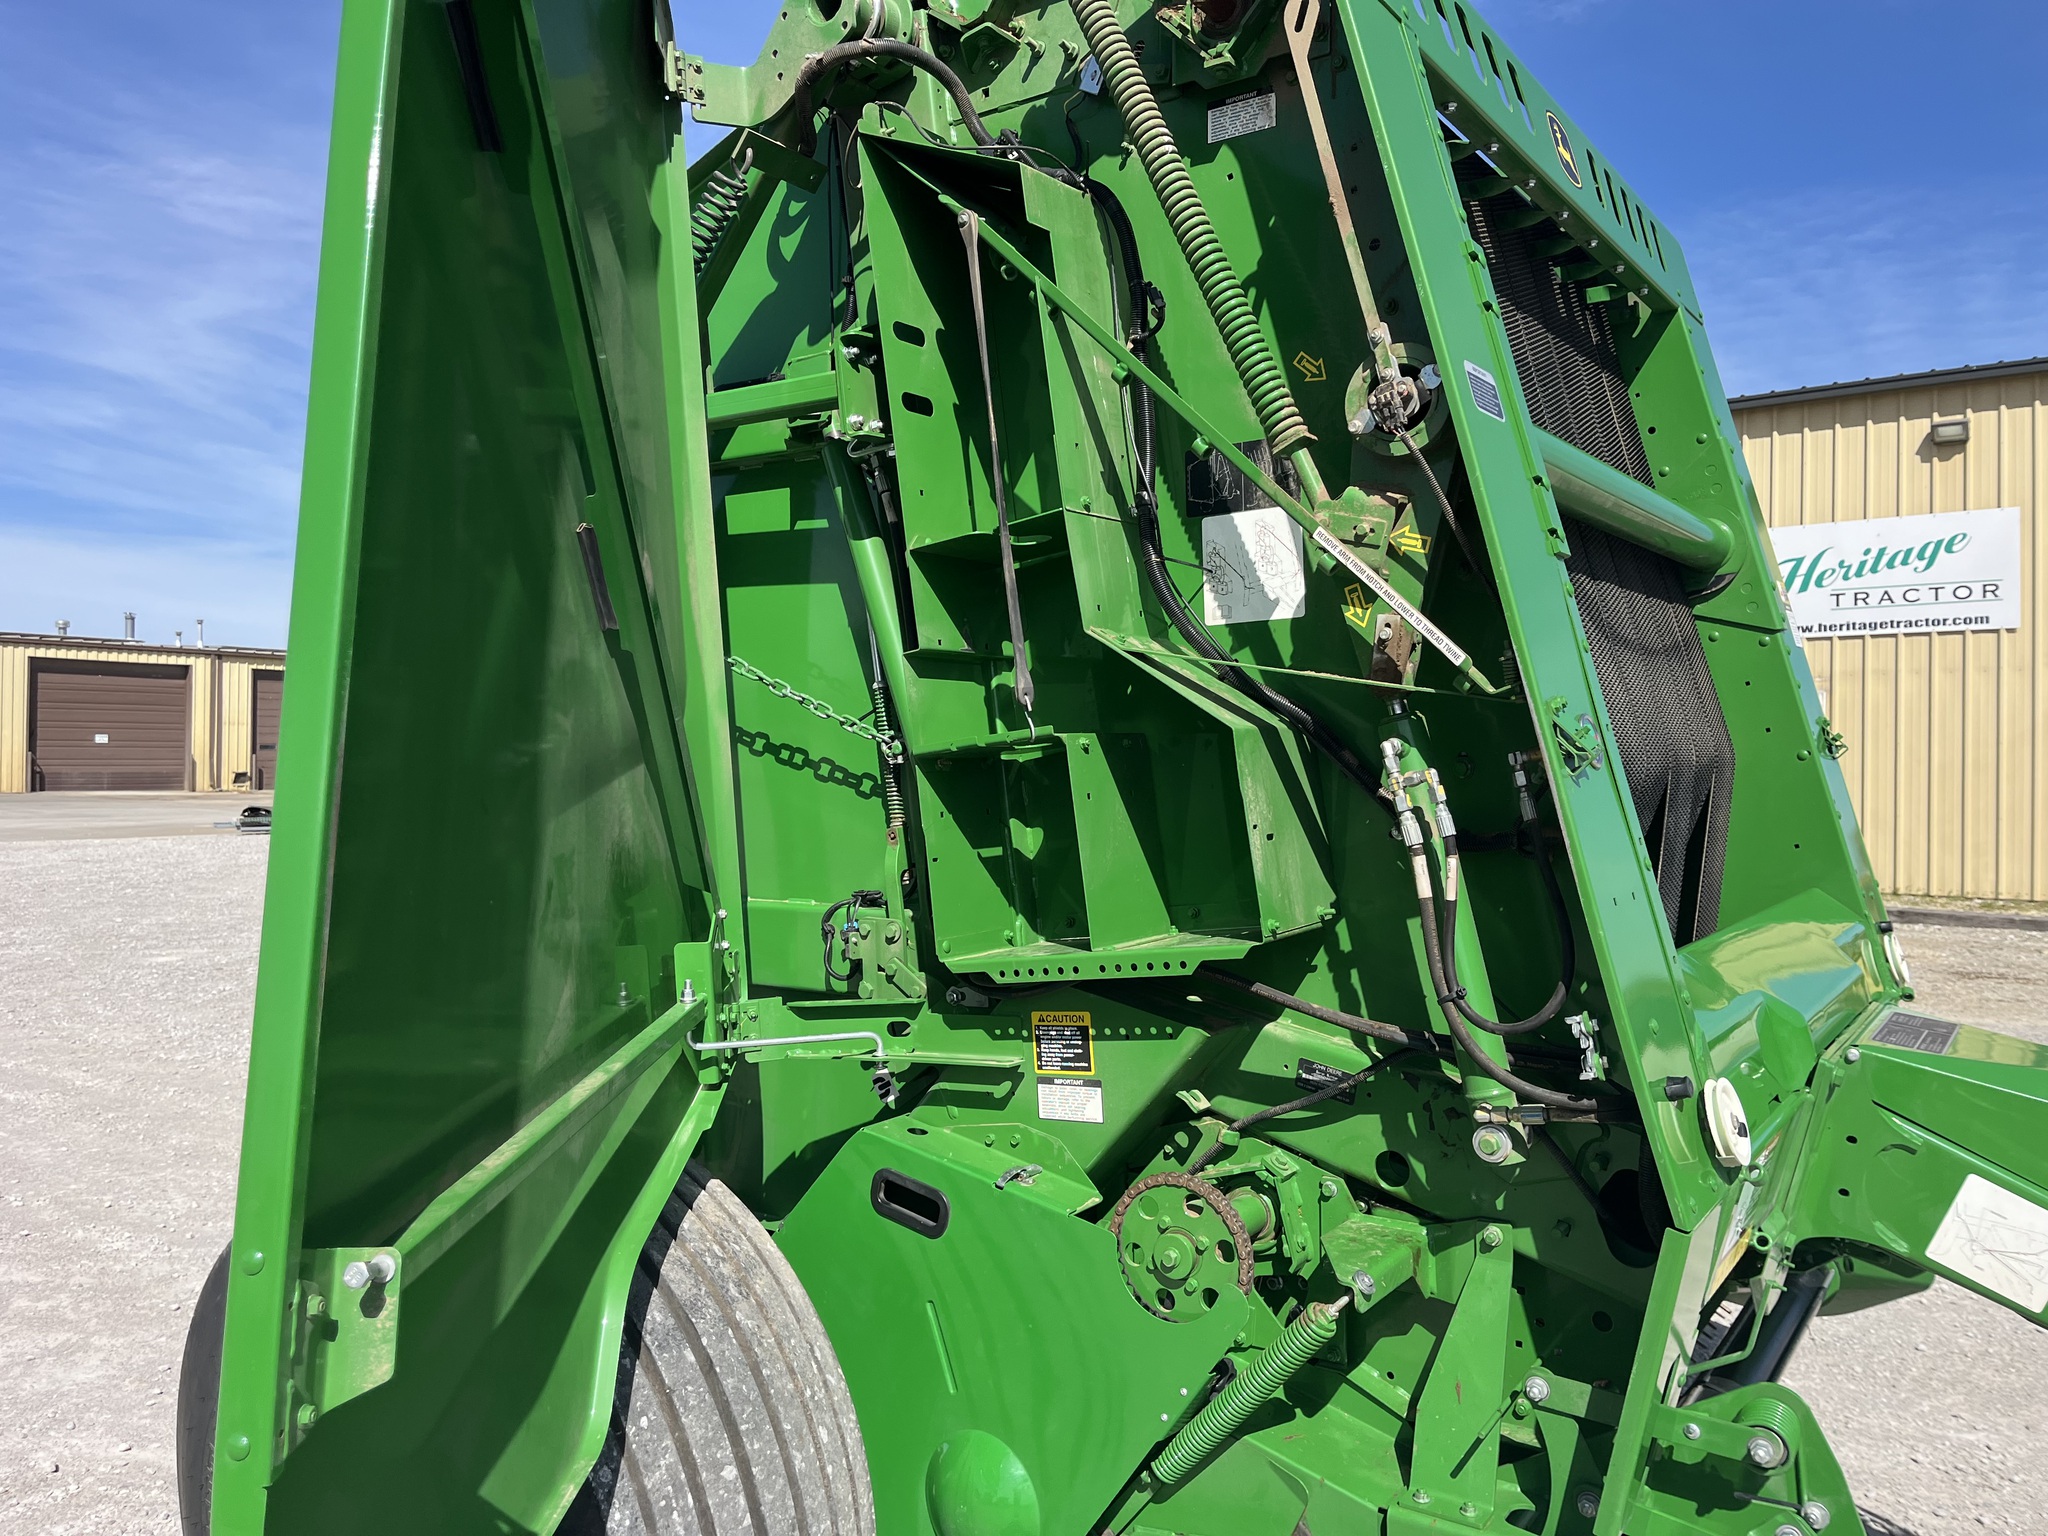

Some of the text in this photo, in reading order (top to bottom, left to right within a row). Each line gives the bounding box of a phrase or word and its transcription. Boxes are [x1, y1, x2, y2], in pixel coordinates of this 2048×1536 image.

[1225, 90, 1258, 104] IMPORTANT
[1778, 532, 1972, 594] Heritage
[1316, 530, 1339, 552] REMOVE
[1337, 549, 1351, 563] ARM
[1349, 559, 1367, 577] FROM
[1365, 573, 1385, 592] NOTCH
[1382, 589, 1396, 602] AND
[1394, 599, 1415, 620] LOWER
[1413, 615, 1423, 627] TO
[1421, 622, 1444, 646] THREAD
[1442, 642, 1462, 662] TWINE
[1830, 583, 2000, 607] TRACTOR
[1045, 1014, 1085, 1023] CAUTION
[1312, 1063, 1326, 1071] JOHN
[1326, 1067, 1342, 1077] DEERE
[1053, 1078, 1084, 1086] IMPORTANT
